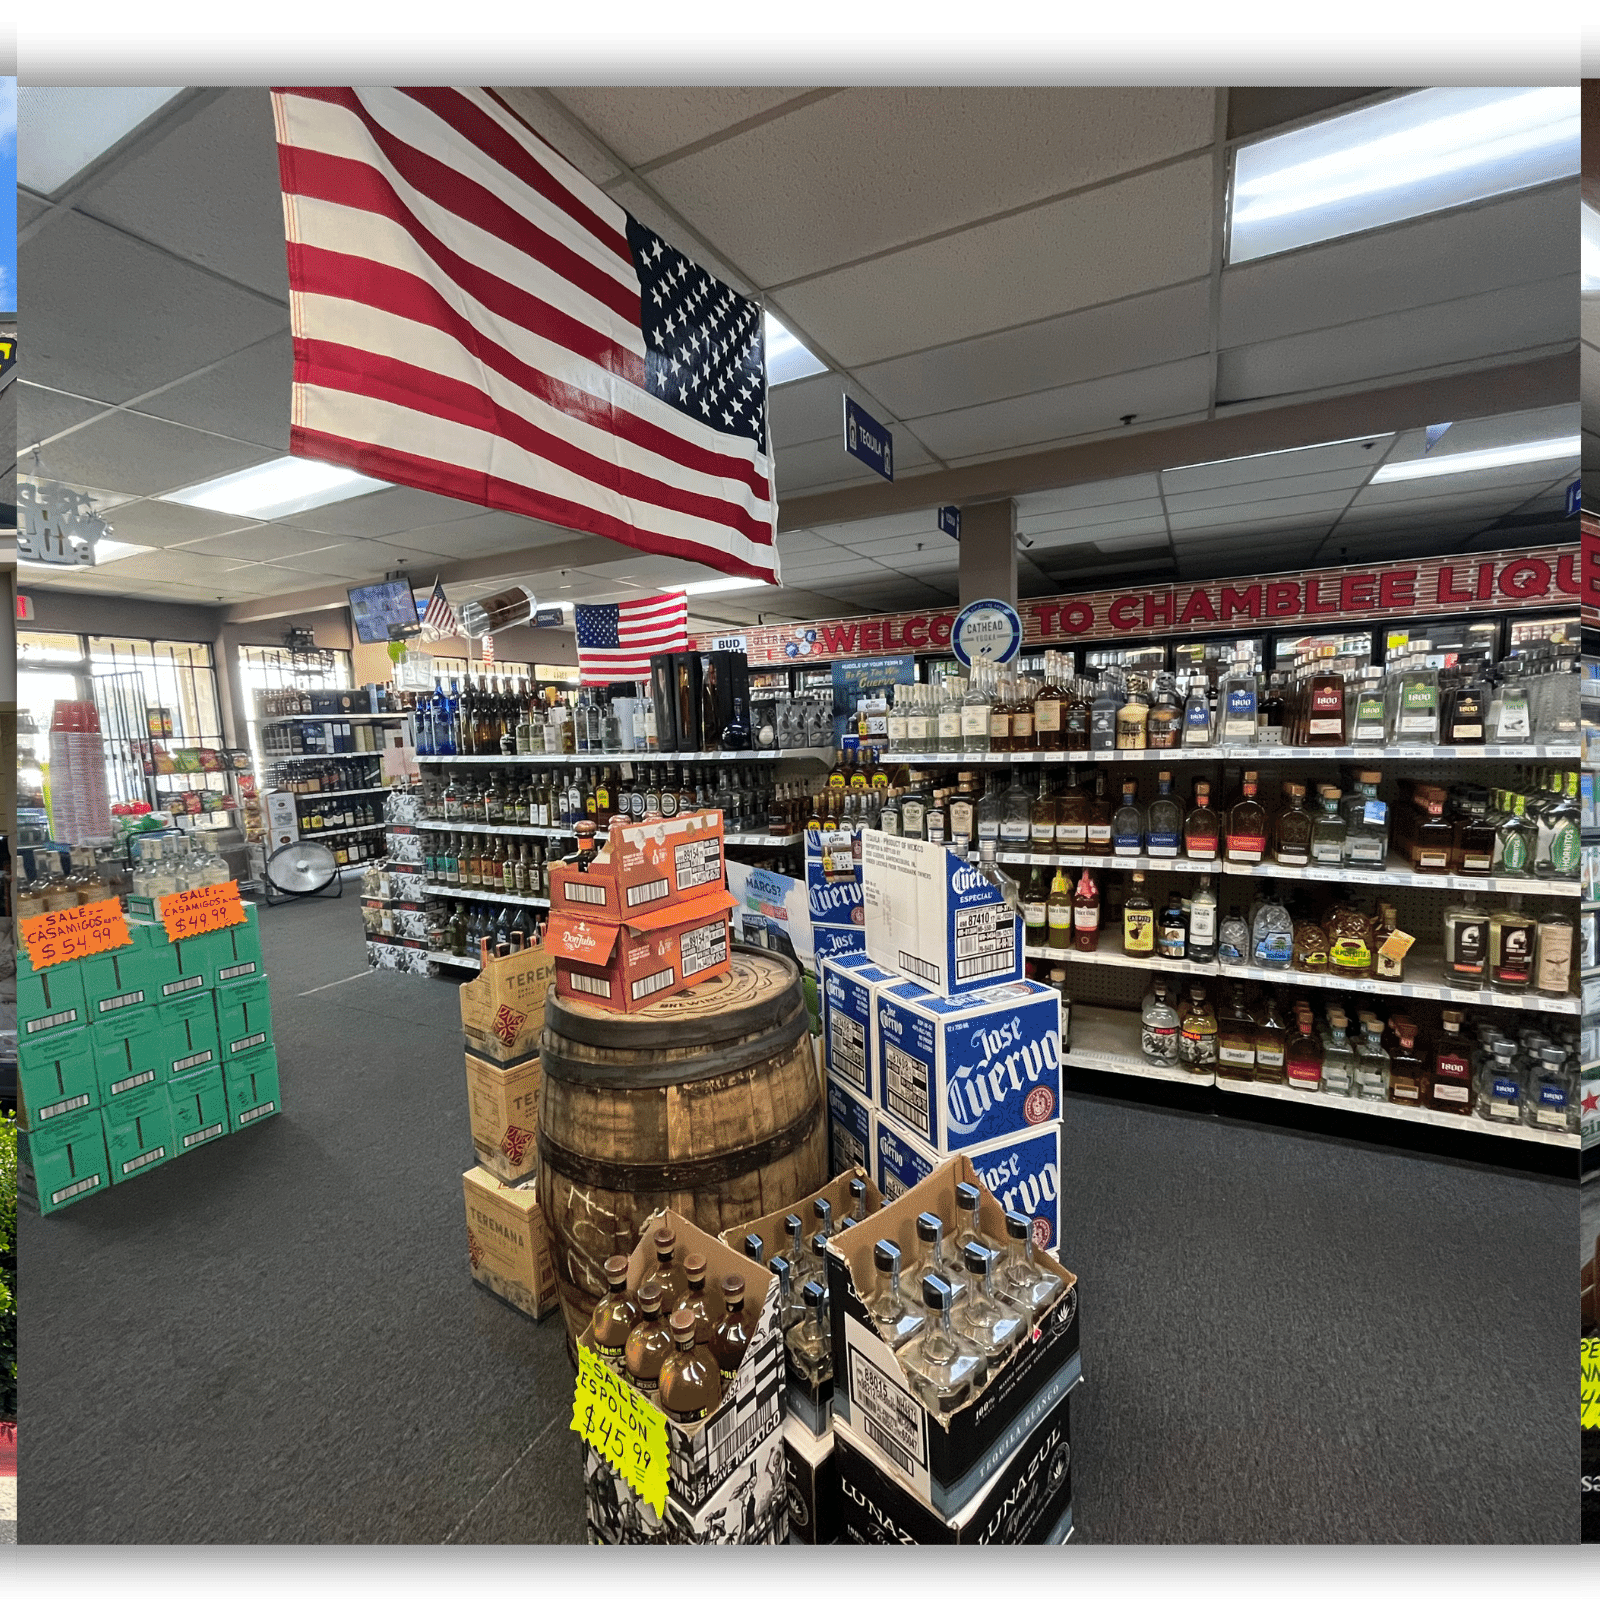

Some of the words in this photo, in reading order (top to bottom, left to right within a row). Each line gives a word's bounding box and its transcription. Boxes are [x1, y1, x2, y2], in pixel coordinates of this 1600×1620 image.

[858, 425, 883, 457] TEQUILA
[1031, 601, 1094, 636] TO
[1108, 569, 1417, 631] CHAMBLEE
[967, 620, 1003, 634] CATHEAD
[718, 639, 740, 649] BUD
[1231, 698, 1251, 708] 1800
[1317, 696, 1338, 706] 1800
[1407, 693, 1431, 703] 1800
[1562, 828, 1574, 871] HORNITOS
[180, 887, 209, 902] SALE
[745, 876, 782, 897] MARGS?
[164, 897, 221, 917] CASAMIGOS
[960, 892, 992, 903] ESPECIAL
[46, 907, 86, 926] SALE
[968, 912, 990, 926] 87410
[27, 916, 103, 944] CASAMIGOS
[971, 1016, 1022, 1061] Jose
[1441, 1062, 1464, 1073] 1800
[947, 1030, 1060, 1134] Cuervo
[593, 1363, 639, 1412] SALE
[580, 1371, 648, 1442] ESPOLON
[980, 1425, 1022, 1478] TEQUILA
[1024, 1384, 1060, 1427] BLANCO
[707, 1459, 733, 1494] AGAVE
[978, 1427, 1062, 1545] LUNAZUL
